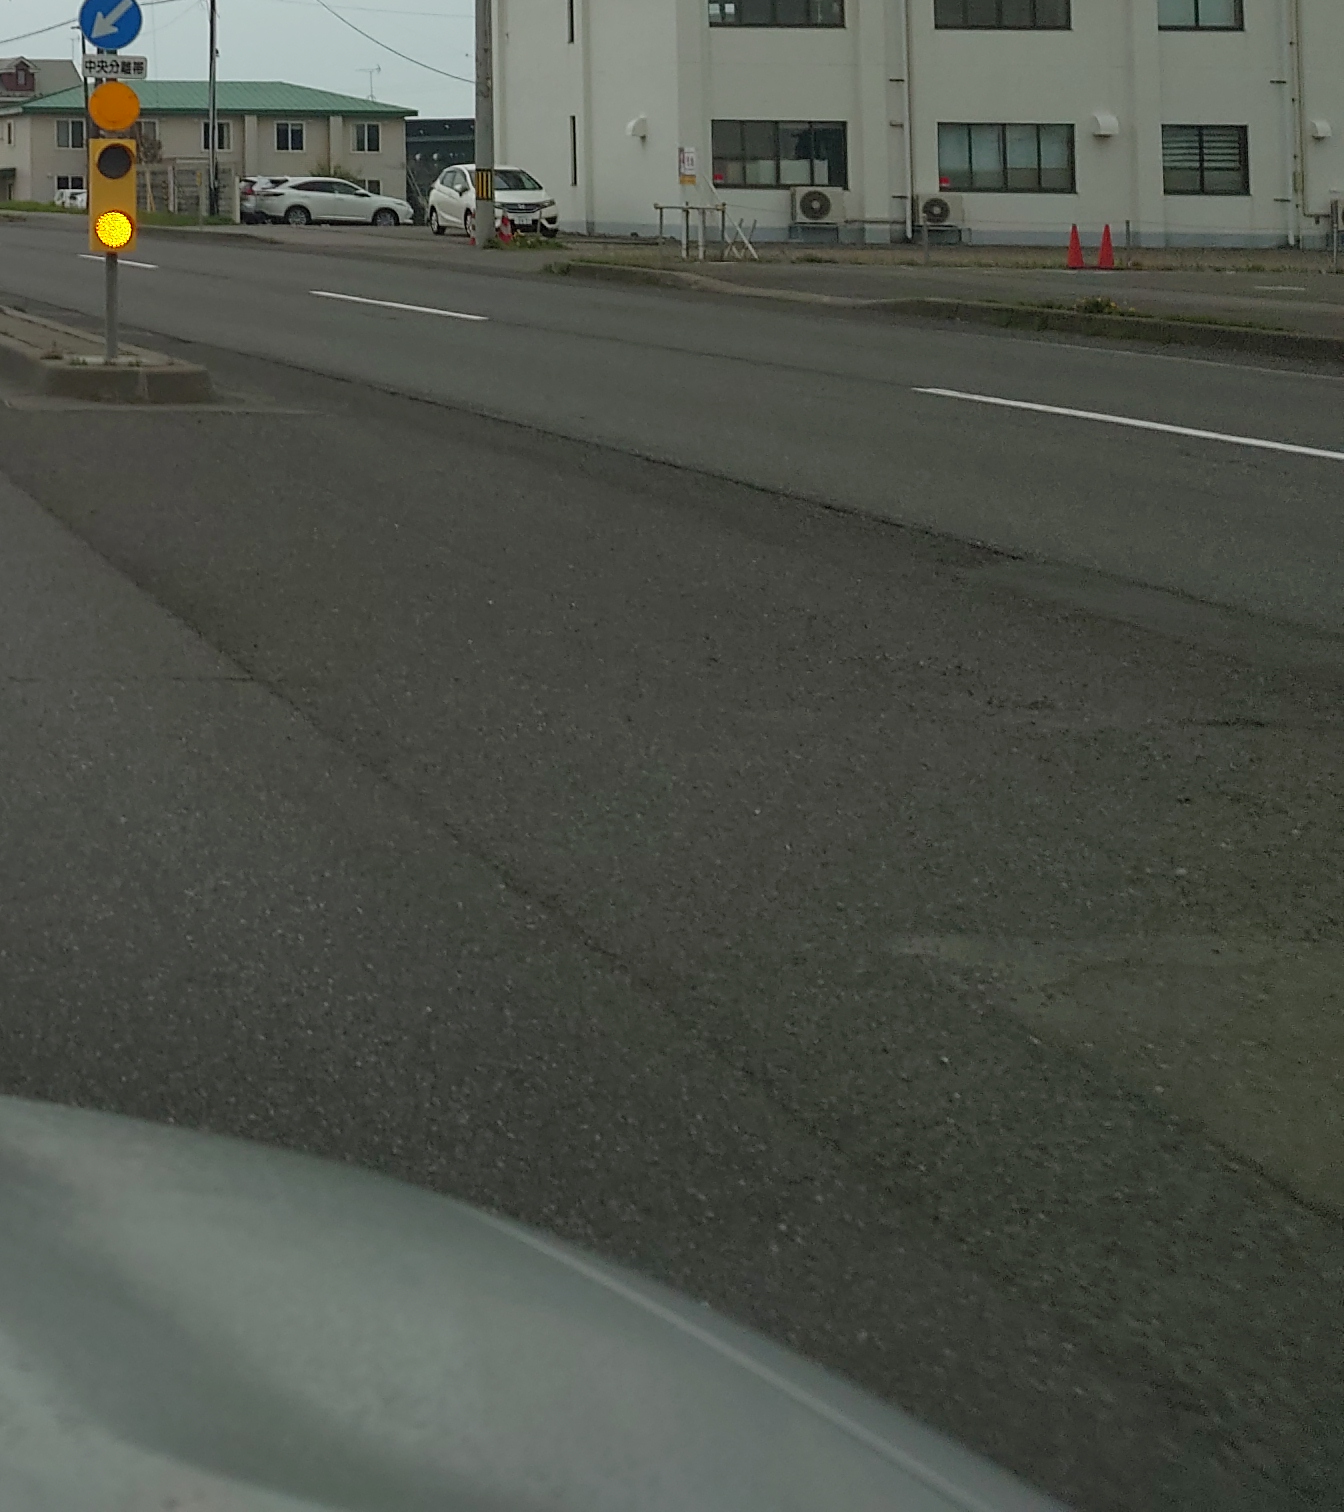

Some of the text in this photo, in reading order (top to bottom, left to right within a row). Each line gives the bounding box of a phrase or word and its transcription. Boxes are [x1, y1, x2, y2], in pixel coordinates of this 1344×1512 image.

[85, 59, 145, 76] 中央分離帯
